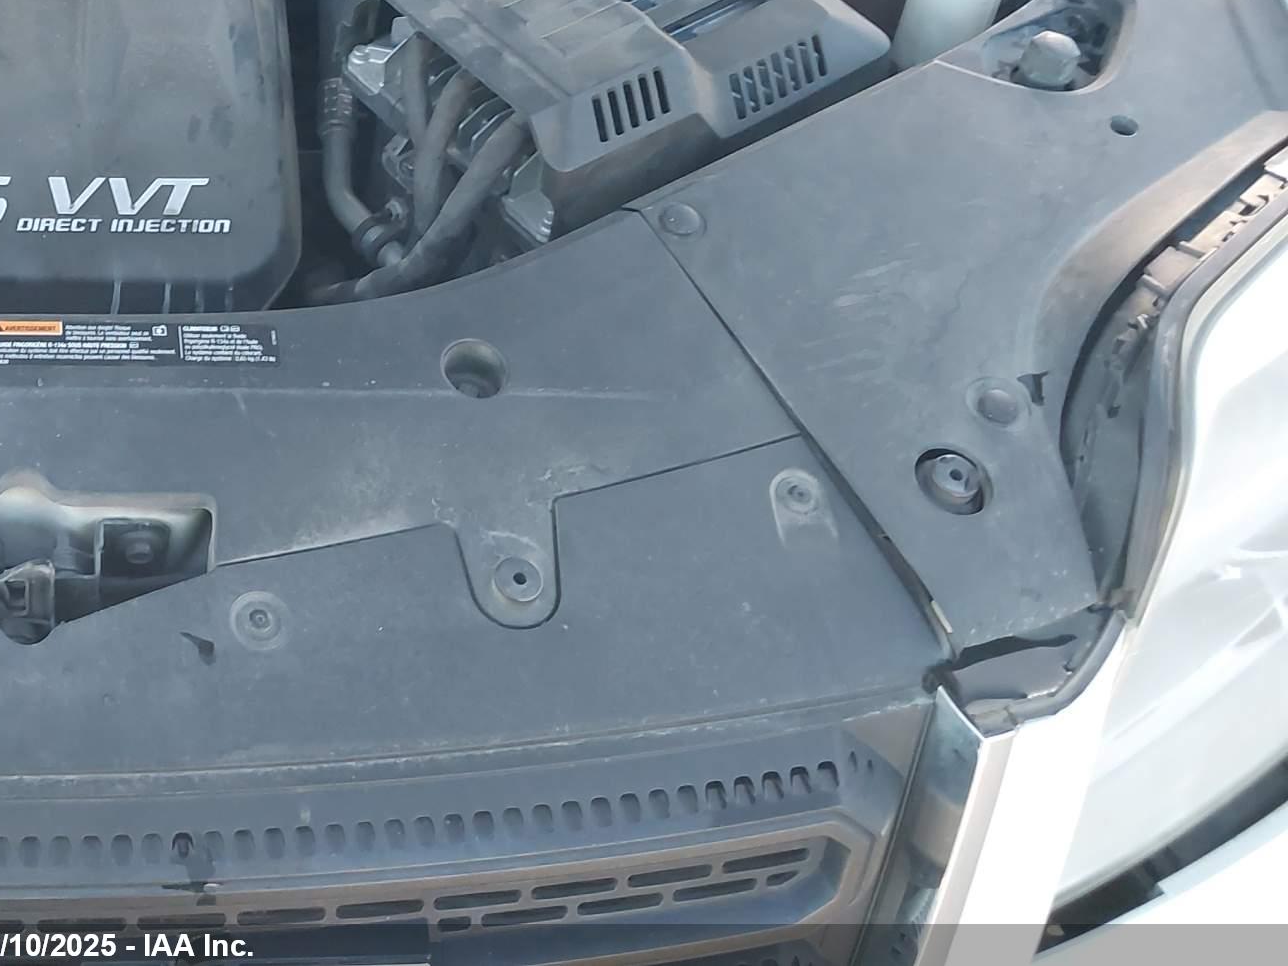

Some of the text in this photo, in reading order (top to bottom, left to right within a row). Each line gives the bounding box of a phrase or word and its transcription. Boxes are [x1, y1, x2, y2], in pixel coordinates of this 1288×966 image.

[48, 177, 209, 214] VVT
[16, 217, 231, 233] DIRECT INJECTION
